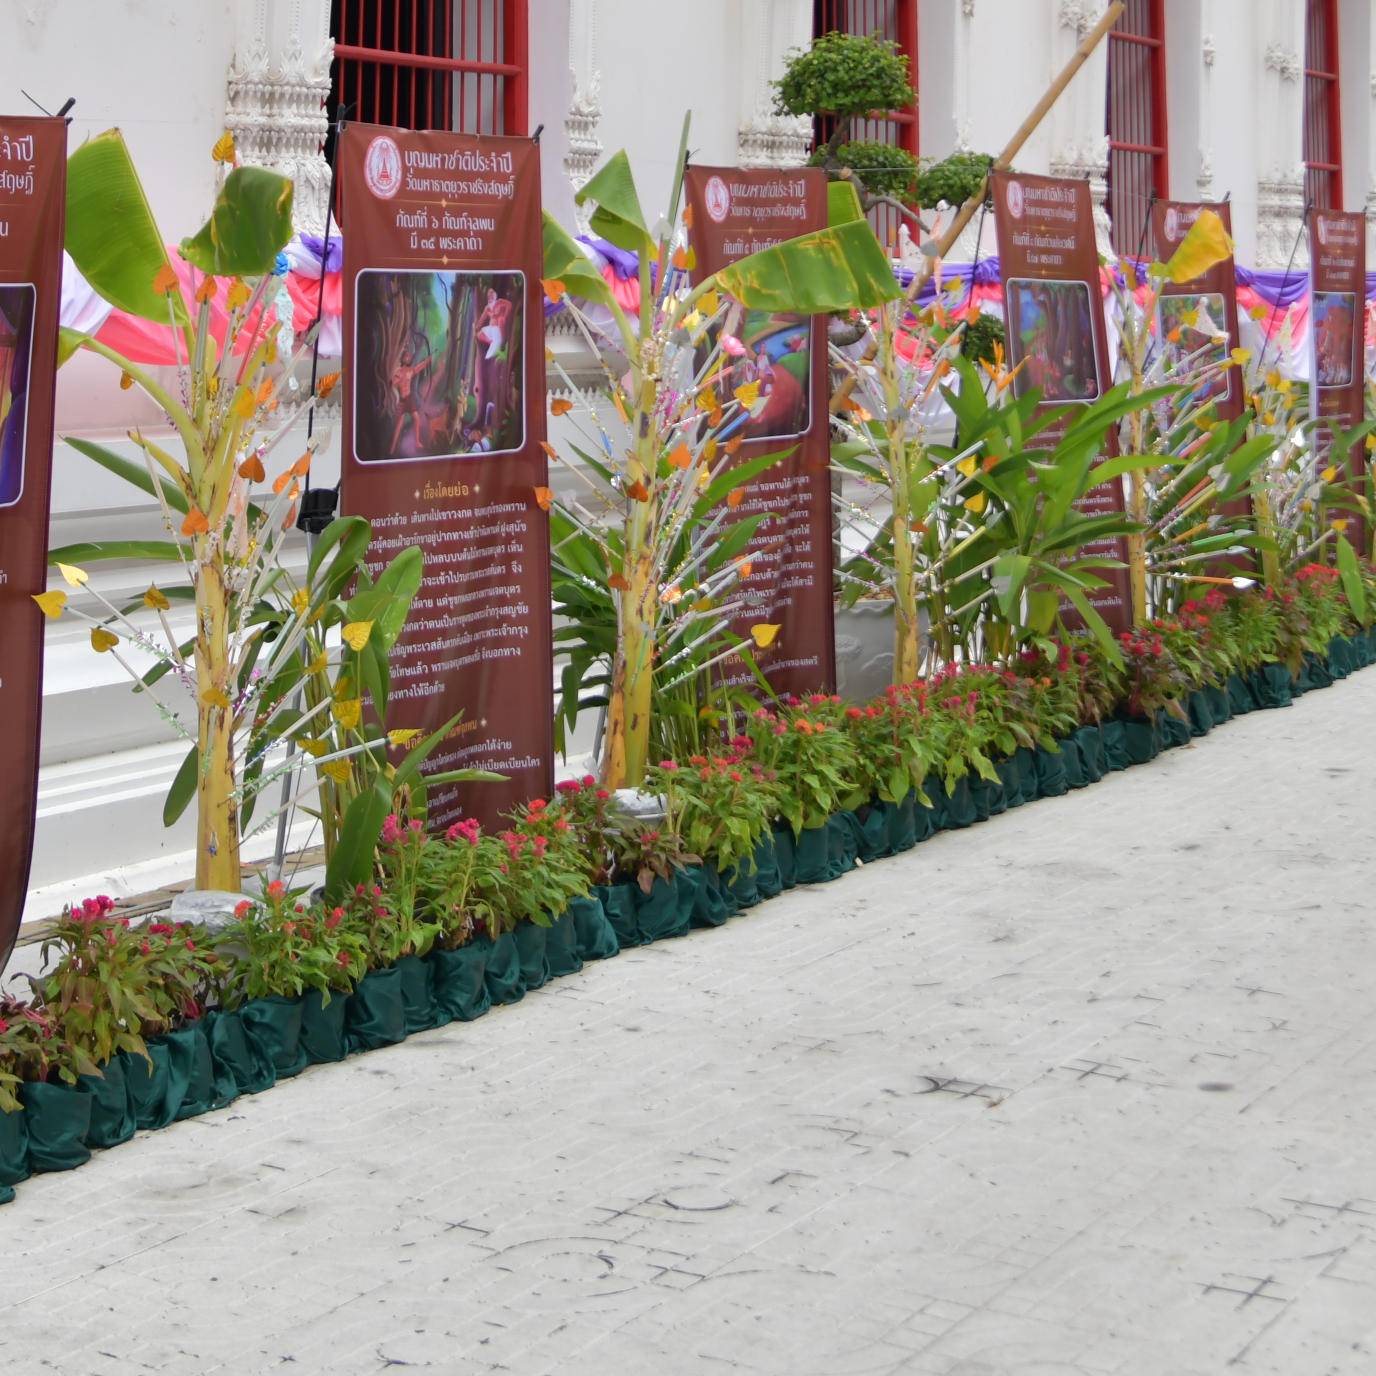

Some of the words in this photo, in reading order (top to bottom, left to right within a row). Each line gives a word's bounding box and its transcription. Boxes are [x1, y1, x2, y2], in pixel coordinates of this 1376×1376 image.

[405, 150, 513, 173] บุญมหาชาติประจำปี
[396, 206, 427, 228] กัณฑ์ที่
[439, 236, 482, 250] พระคาถา
[424, 480, 469, 499] เรื่องโดยย่อ
